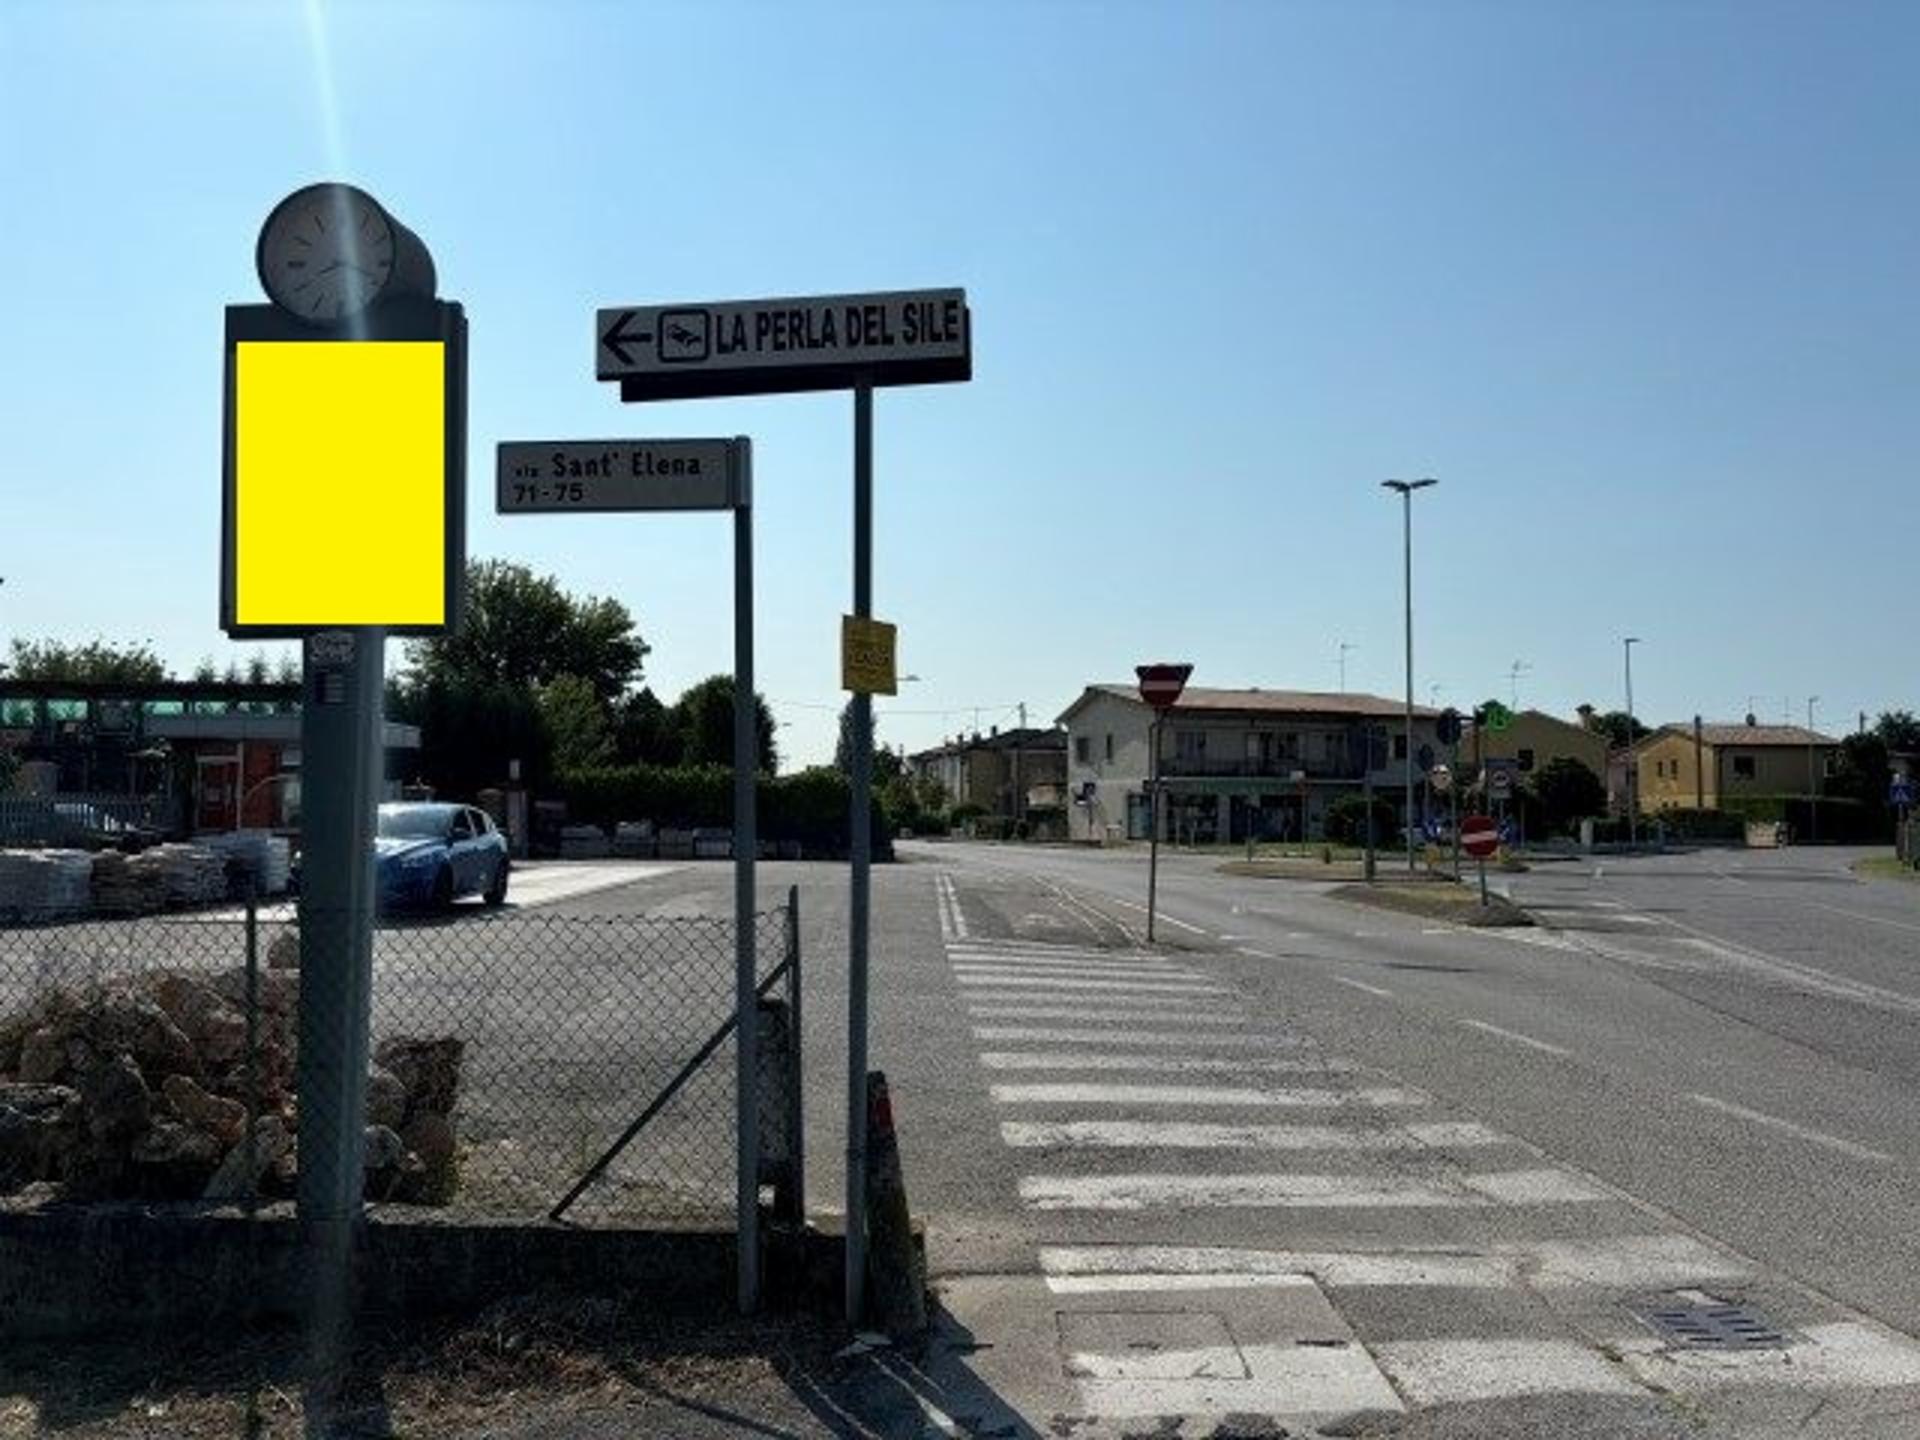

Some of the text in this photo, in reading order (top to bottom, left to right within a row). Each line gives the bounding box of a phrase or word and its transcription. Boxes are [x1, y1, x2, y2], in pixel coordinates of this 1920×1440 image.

[716, 300, 960, 354] LA PERLA DEL SILE
[551, 452, 619, 478] Sant'
[631, 452, 702, 477] Elena
